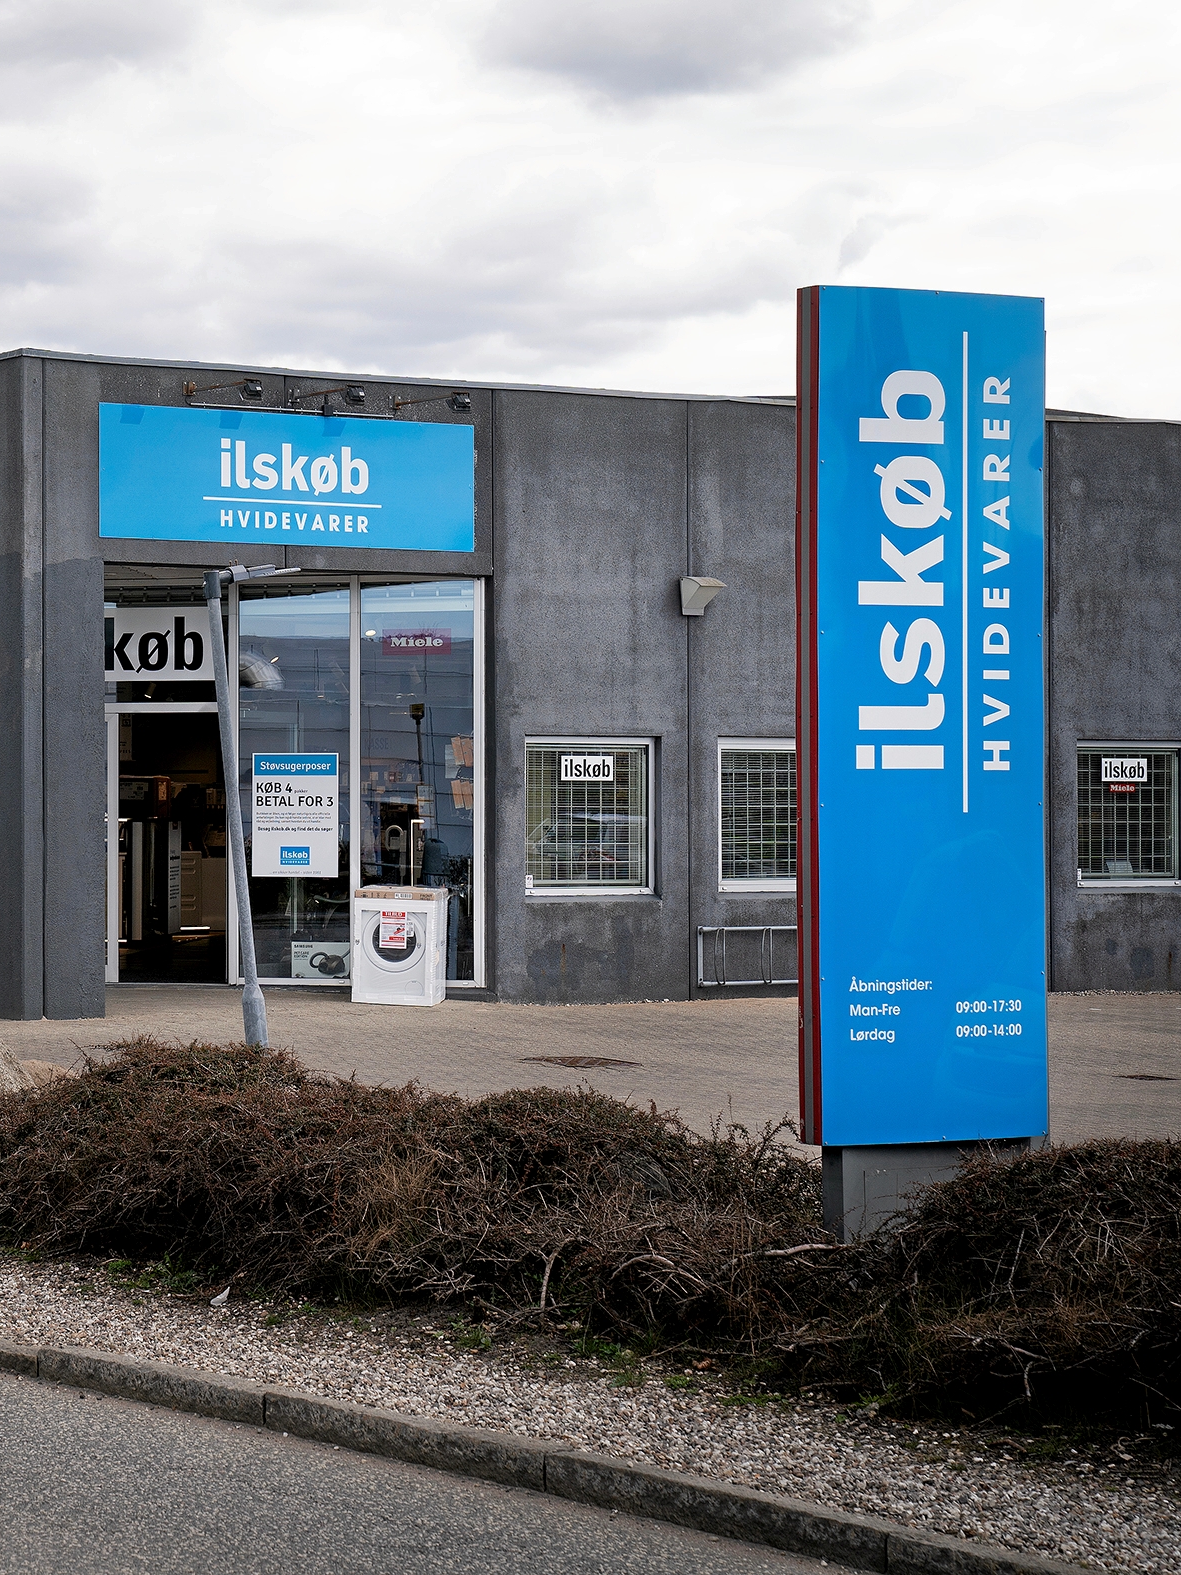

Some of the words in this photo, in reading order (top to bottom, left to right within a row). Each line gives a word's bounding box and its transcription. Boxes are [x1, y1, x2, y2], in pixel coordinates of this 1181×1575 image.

[221, 437, 370, 496] ilskøb
[220, 508, 369, 534] HVIDEVARER
[856, 370, 952, 769] ilskøb
[983, 376, 1010, 771] HVIDEVARER
[105, 617, 203, 673] køb
[390, 637, 443, 647] Miele
[260, 761, 331, 772] Støvsugerposer
[564, 758, 610, 778] ilskøb
[1104, 761, 1145, 779] ilskøb
[256, 781, 282, 794] KØB
[285, 782, 292, 793] 4
[256, 795, 294, 807] BETAL
[298, 795, 323, 807] FOR
[326, 796, 334, 807] 3
[282, 850, 308, 859] ilskøb
[849, 976, 933, 995] Åbningstider:
[849, 1003, 901, 1016] Man-Fre
[955, 999, 1022, 1014] 09:00-17:30
[850, 1028, 895, 1043] Lørdag
[956, 1023, 1022, 1038] 09:00-14:00
